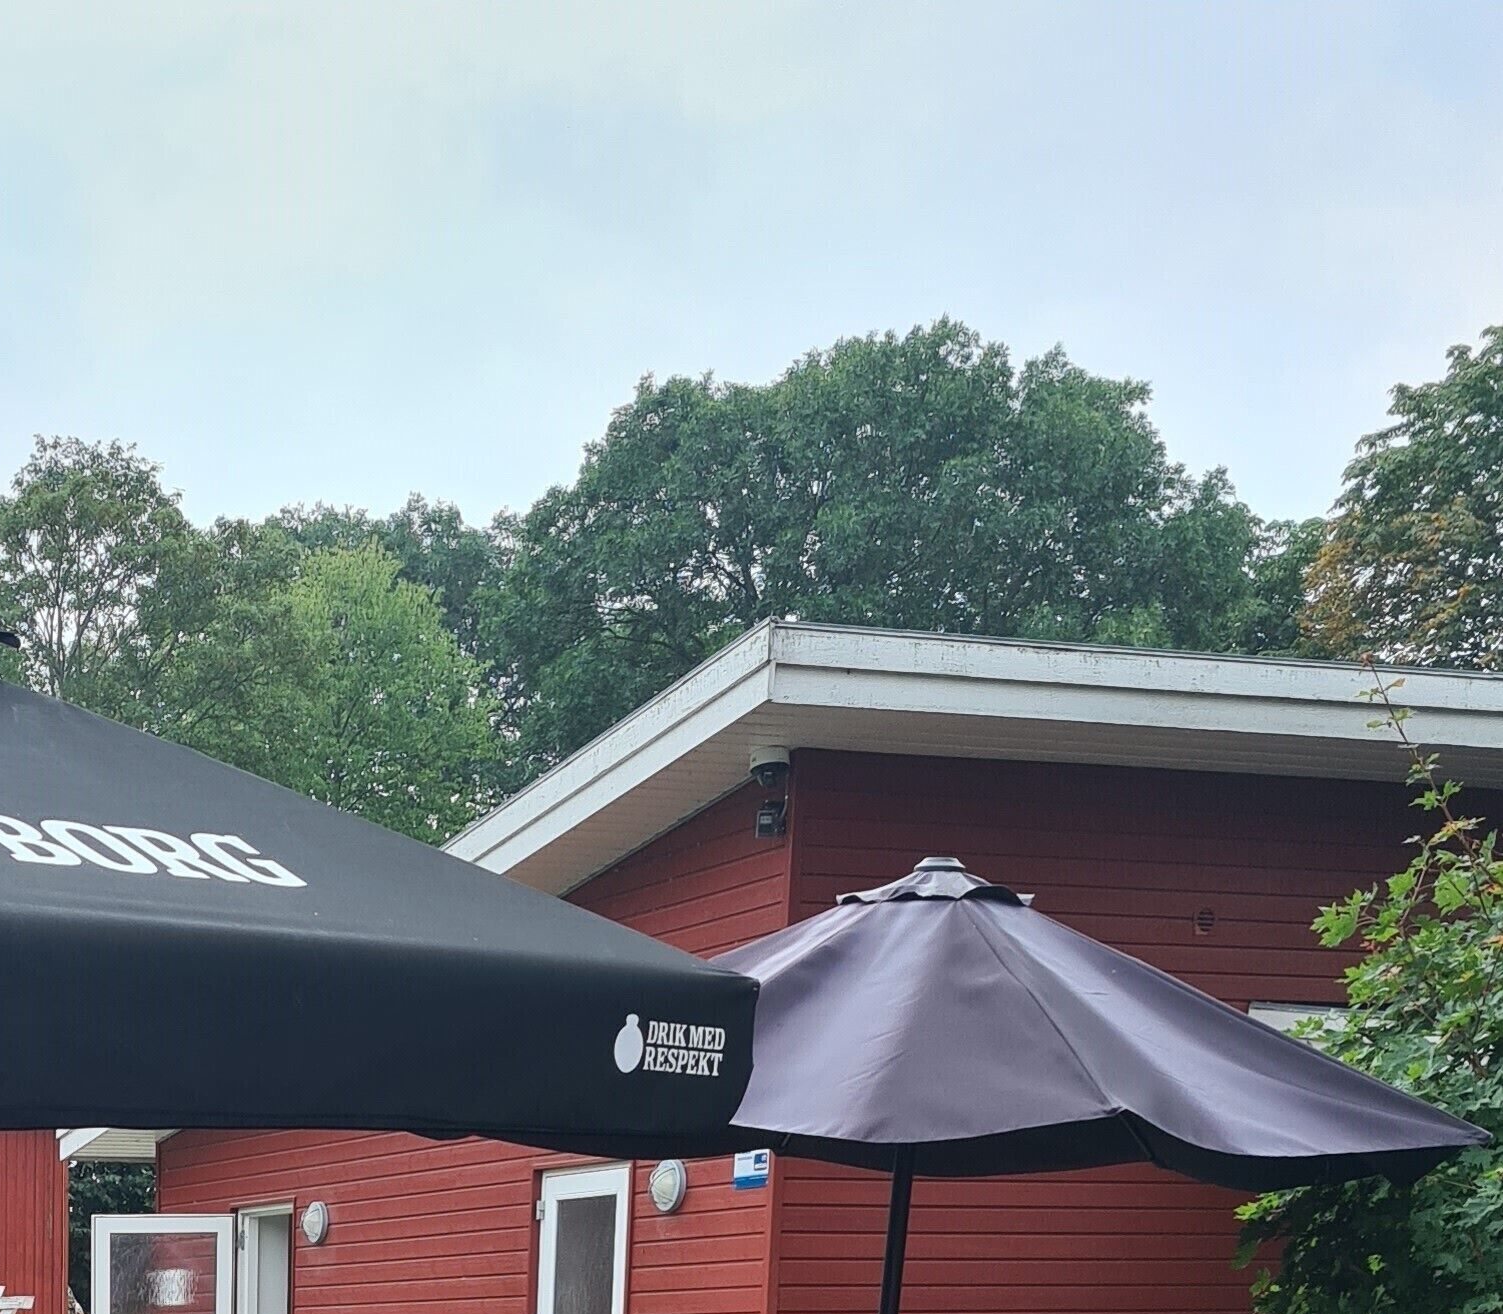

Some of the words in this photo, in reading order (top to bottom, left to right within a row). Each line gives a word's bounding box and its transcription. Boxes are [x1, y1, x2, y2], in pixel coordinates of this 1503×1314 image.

[646, 1020, 688, 1047] DRIK
[688, 1025, 726, 1051] MED
[642, 1046, 724, 1077] RESPEKT
